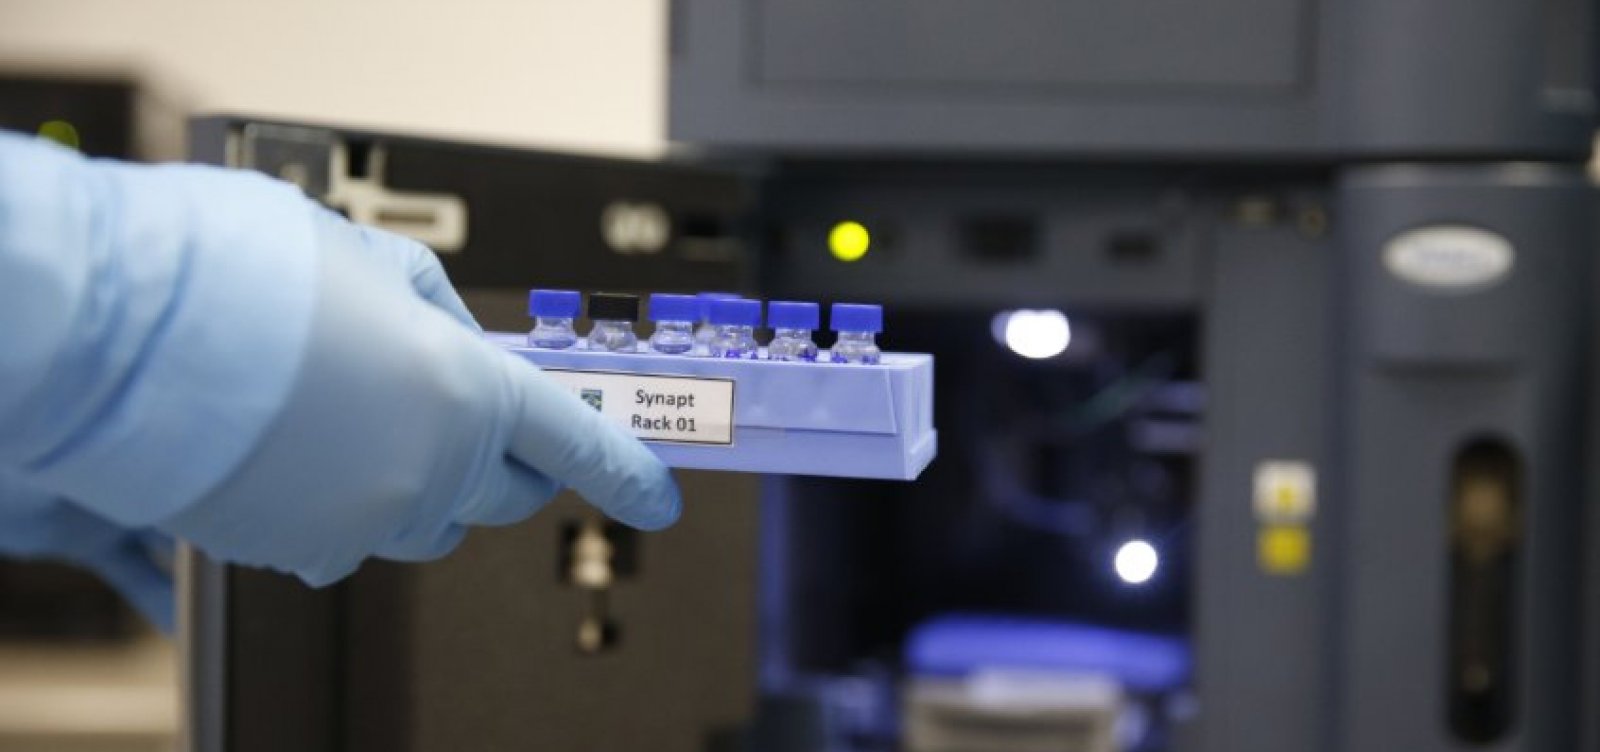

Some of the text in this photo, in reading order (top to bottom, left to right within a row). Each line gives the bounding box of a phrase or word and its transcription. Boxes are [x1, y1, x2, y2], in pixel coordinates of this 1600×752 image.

[635, 389, 695, 408] Synapt
[631, 414, 697, 432] Rack 01
